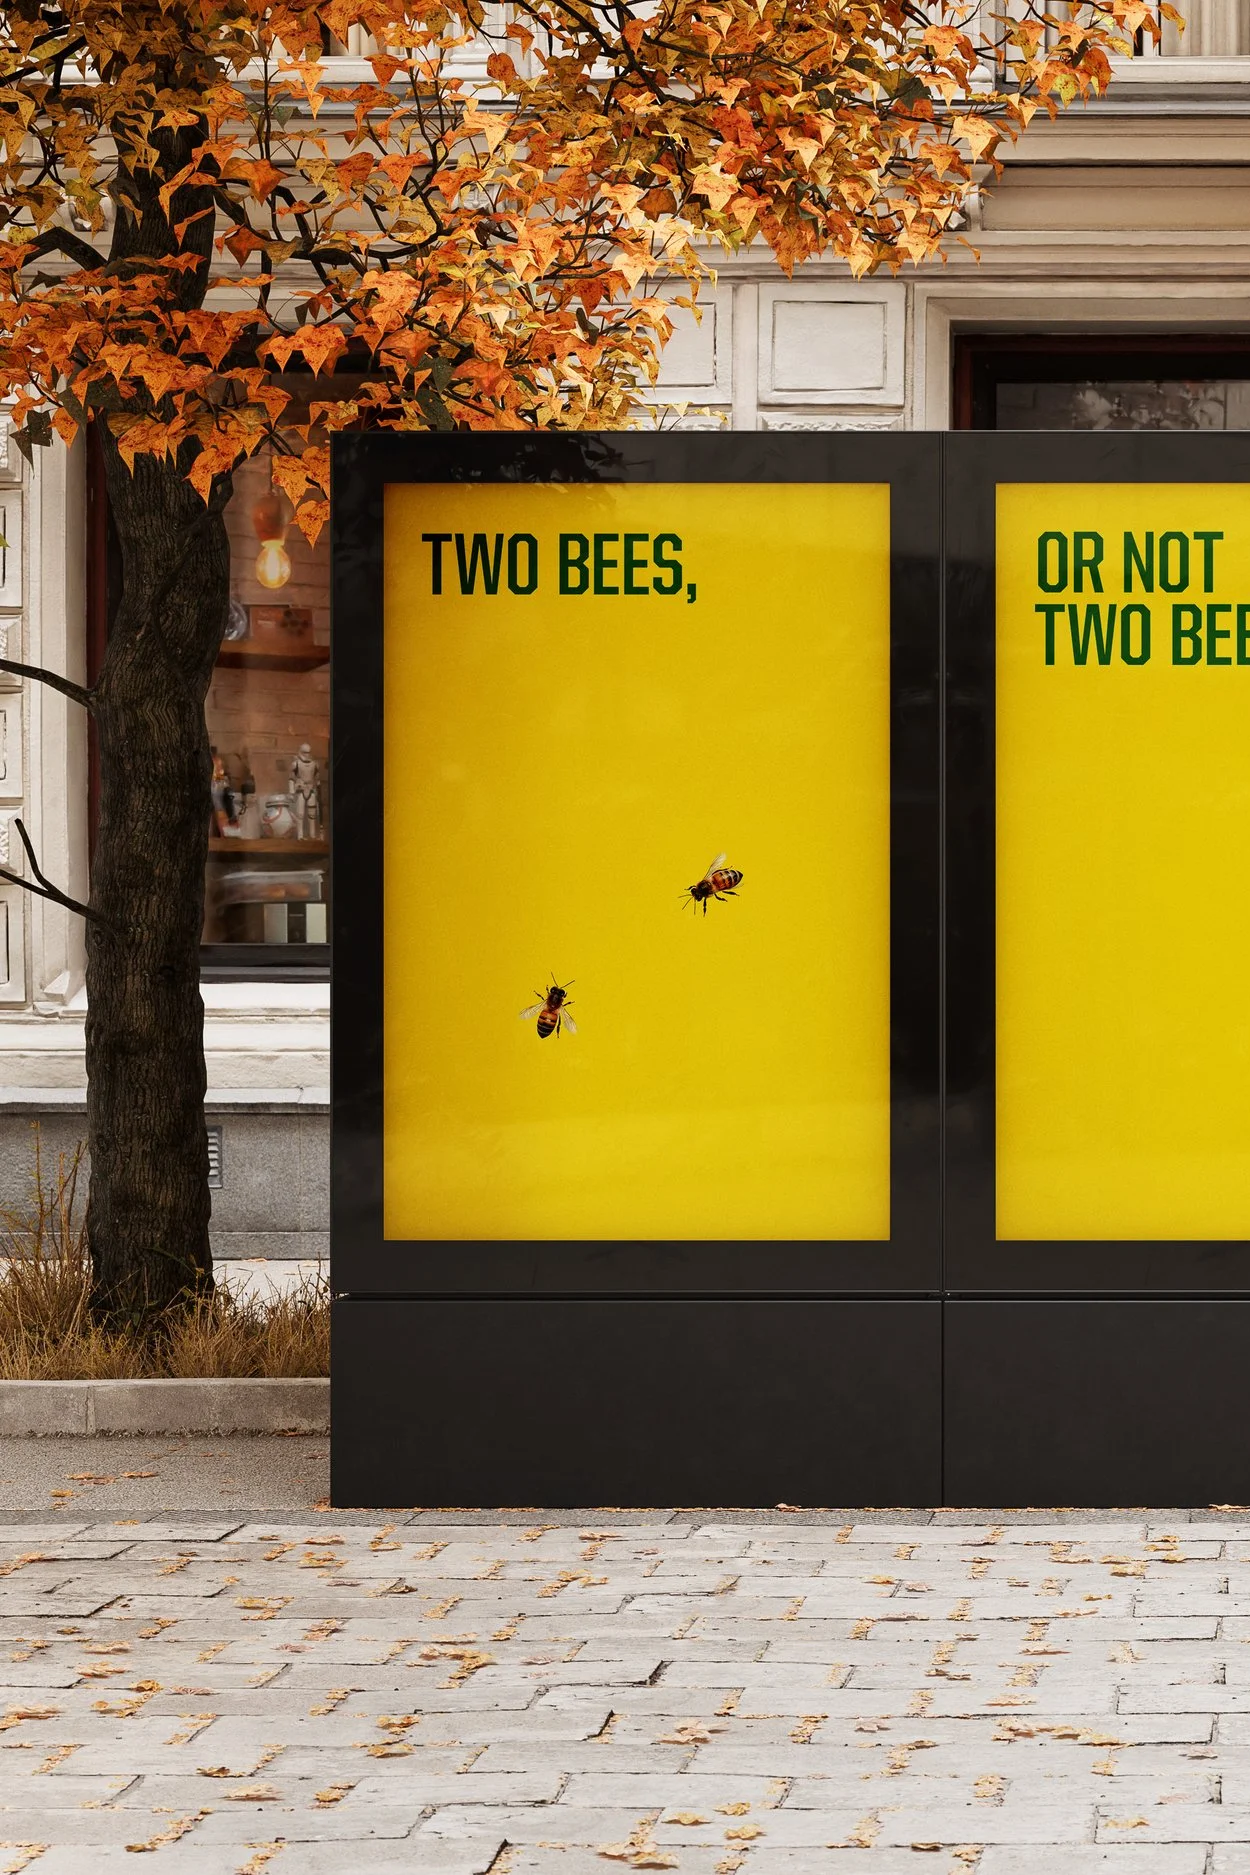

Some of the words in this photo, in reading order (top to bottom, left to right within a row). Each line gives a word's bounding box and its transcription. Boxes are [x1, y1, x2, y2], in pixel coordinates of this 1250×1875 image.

[421, 533, 538, 596] TWO
[559, 533, 697, 604] BEES,
[1037, 531, 1105, 594] OR
[1123, 531, 1224, 594] NOT
[1034, 603, 1151, 666] TWO
